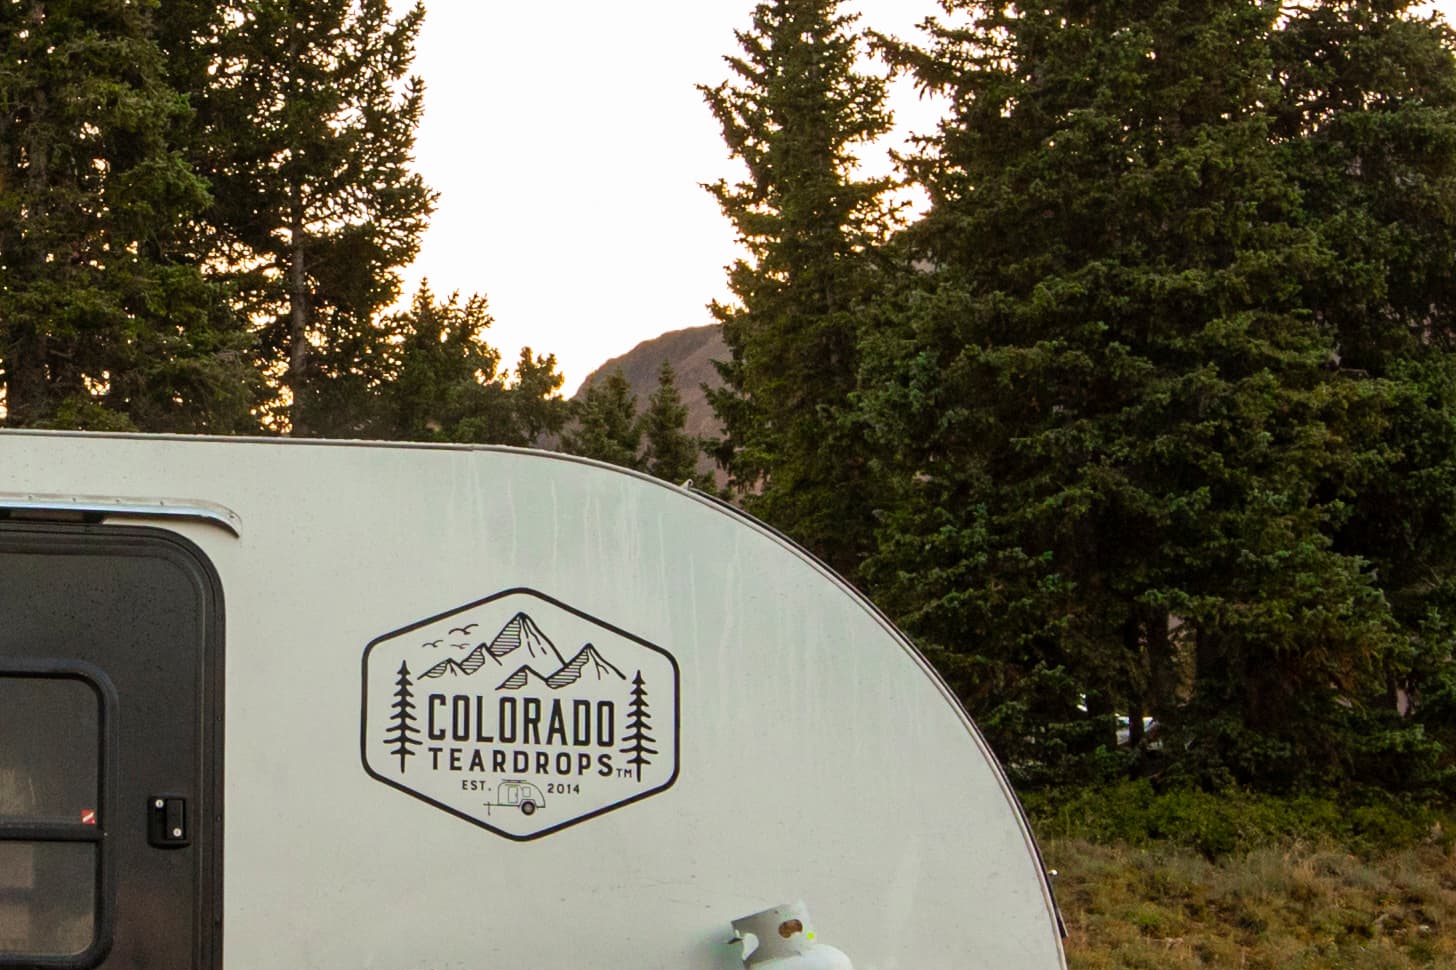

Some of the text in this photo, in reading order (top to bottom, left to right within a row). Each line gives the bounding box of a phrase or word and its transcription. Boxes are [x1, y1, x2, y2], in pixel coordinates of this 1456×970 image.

[428, 693, 614, 747] COLORADO
[428, 747, 613, 777] TEARDROPS
[461, 779, 581, 795] EST. 2014
